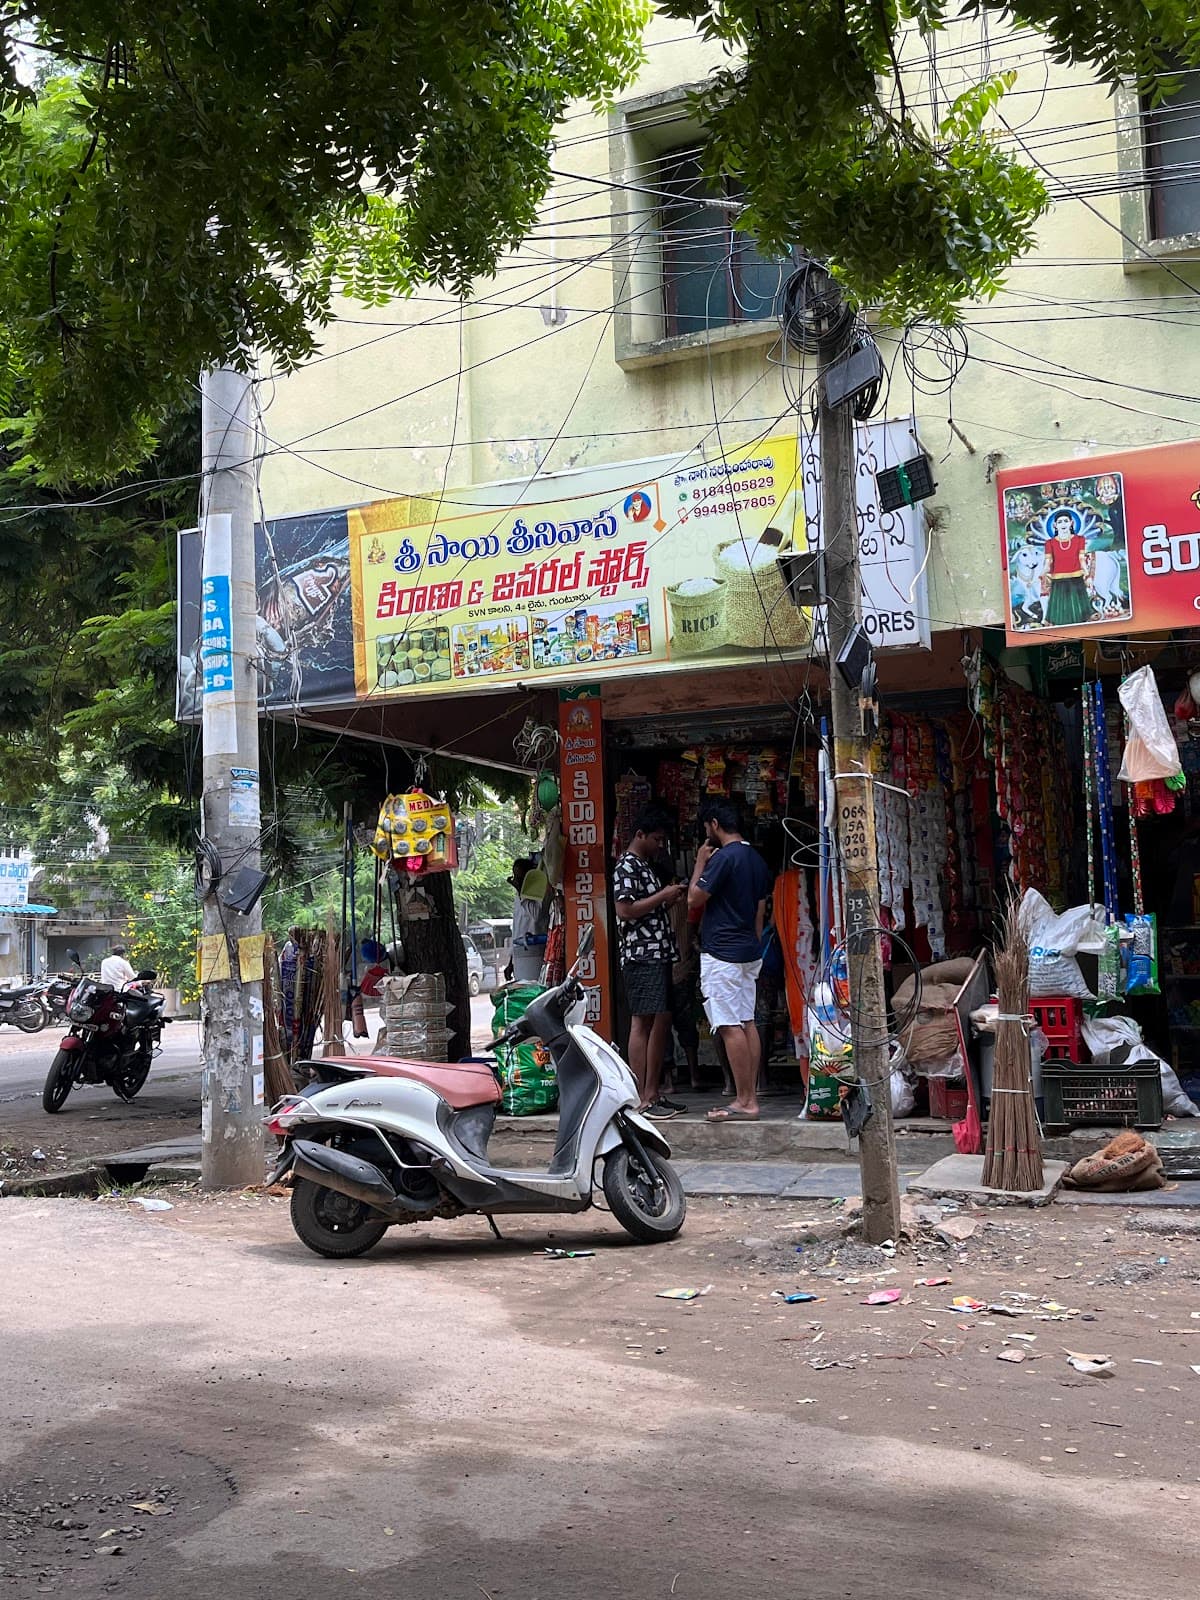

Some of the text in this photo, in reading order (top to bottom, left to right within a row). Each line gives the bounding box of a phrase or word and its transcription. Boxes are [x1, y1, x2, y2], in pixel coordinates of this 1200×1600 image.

[688, 467, 707, 481] నాగ
[692, 476, 774, 499] 8184905829
[694, 495, 776, 518] 9949857805
[393, 508, 618, 574] శ్రీ సాయి శ్రీనివాస
[376, 540, 650, 618] కిరాణా & జనరల్ స్టోర్స్
[468, 607, 486, 618] SVN
[681, 611, 719, 633] RICE
[864, 610, 915, 635] ORES
